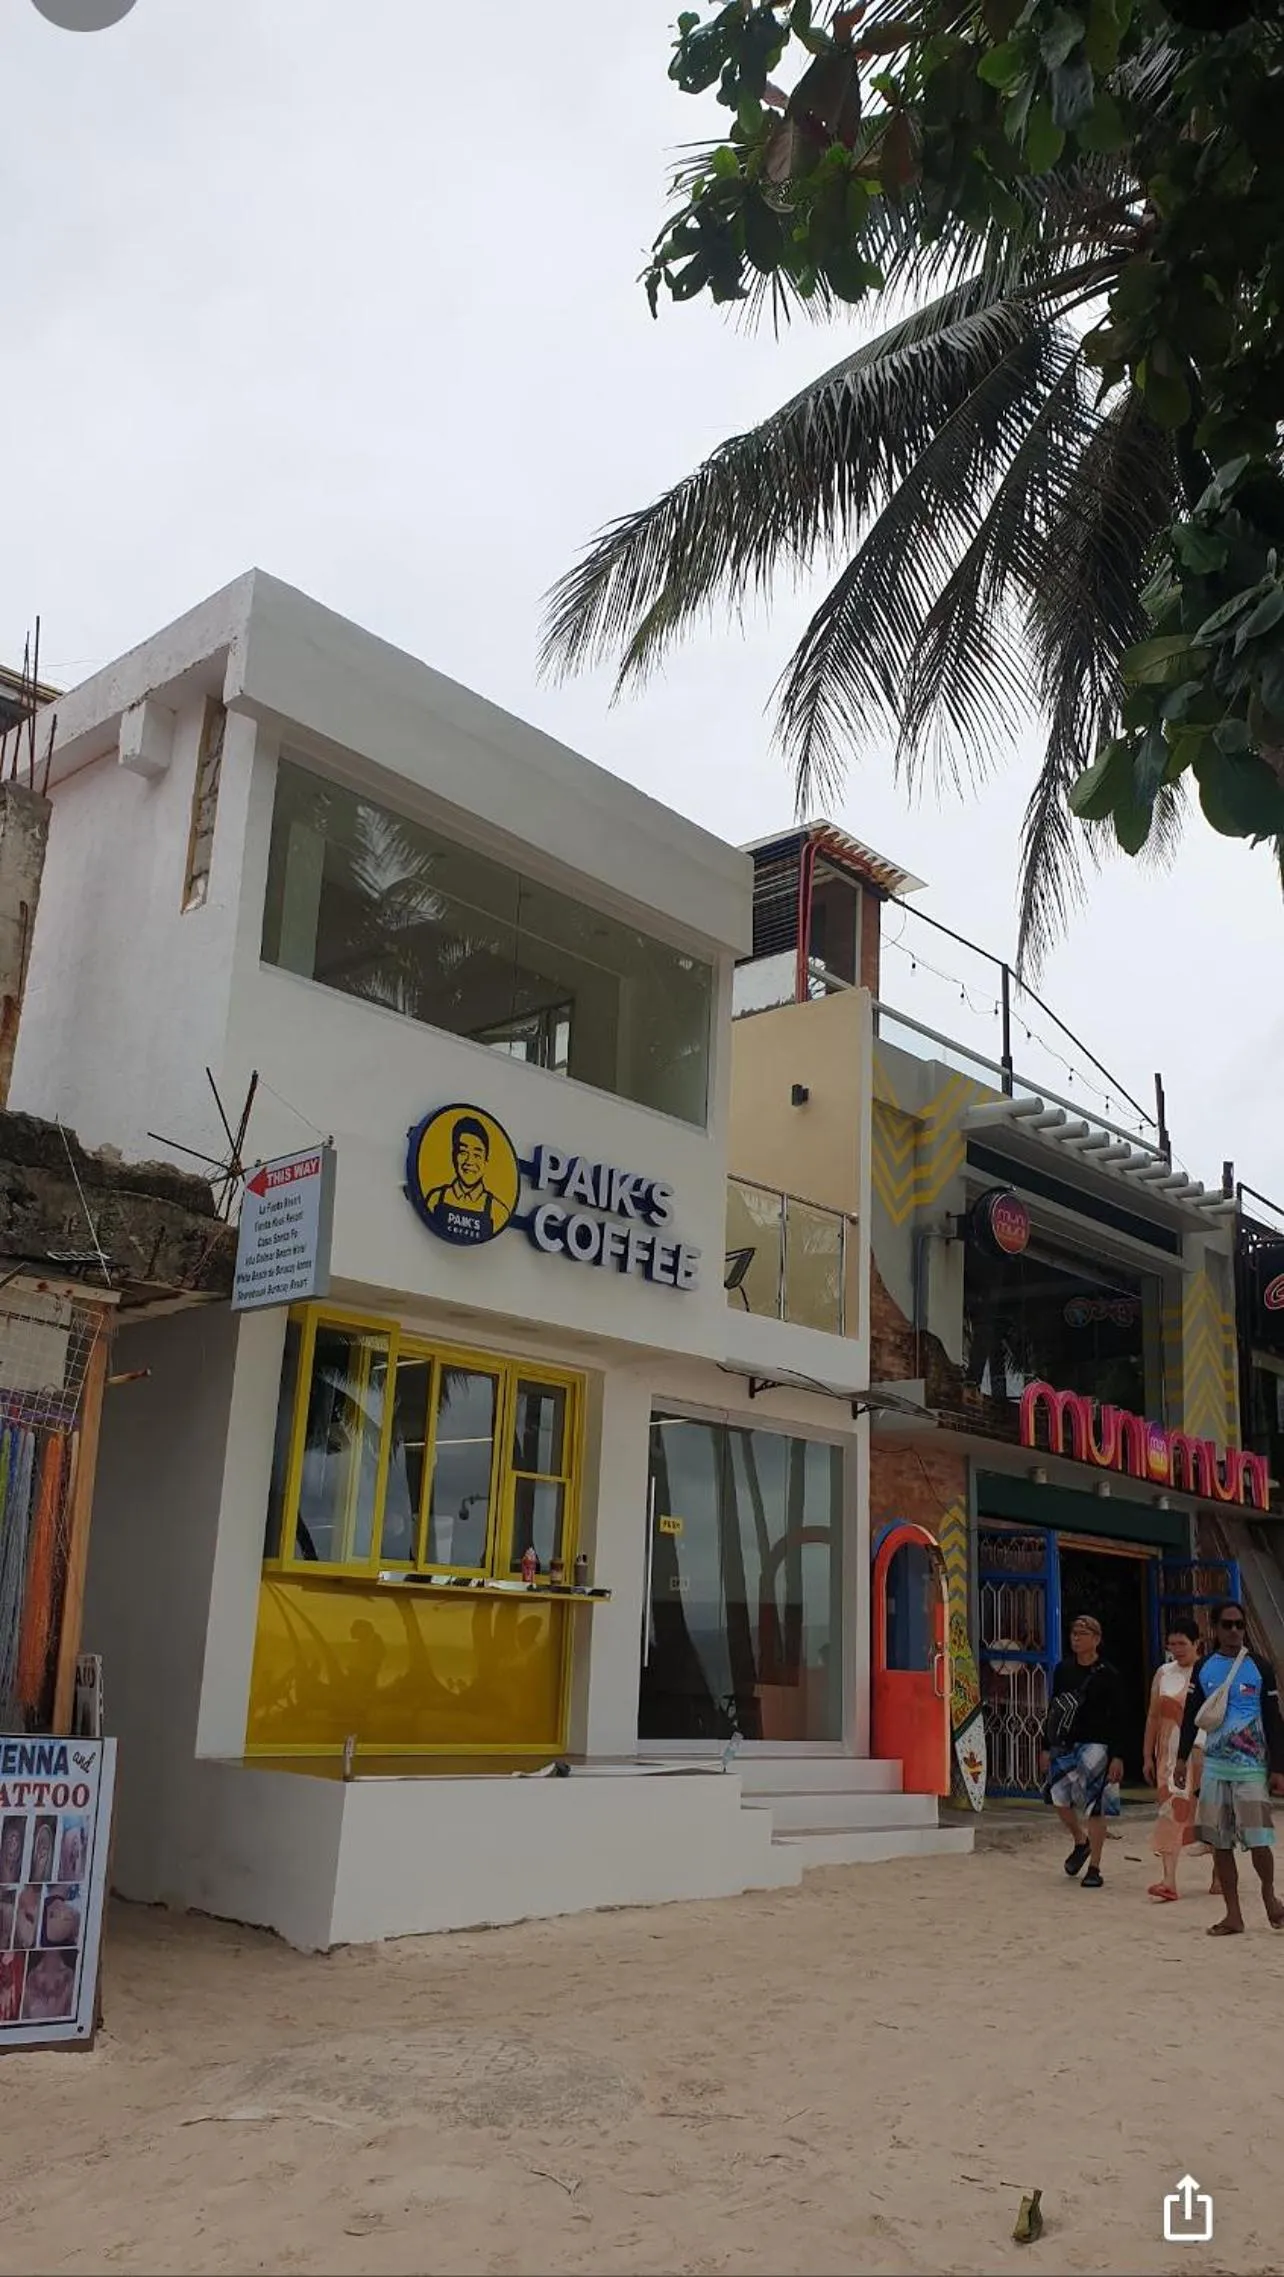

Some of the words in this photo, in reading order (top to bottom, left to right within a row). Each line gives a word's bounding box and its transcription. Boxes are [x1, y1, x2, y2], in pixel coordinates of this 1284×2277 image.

[266, 1167, 292, 1187] THIS
[293, 1158, 318, 1178] WAY
[535, 1144, 675, 1226] PAIK'S
[448, 1212, 480, 1230] PAIK'S
[531, 1203, 702, 1290] COFFEE
[0, 1744, 69, 1776] ENNA
